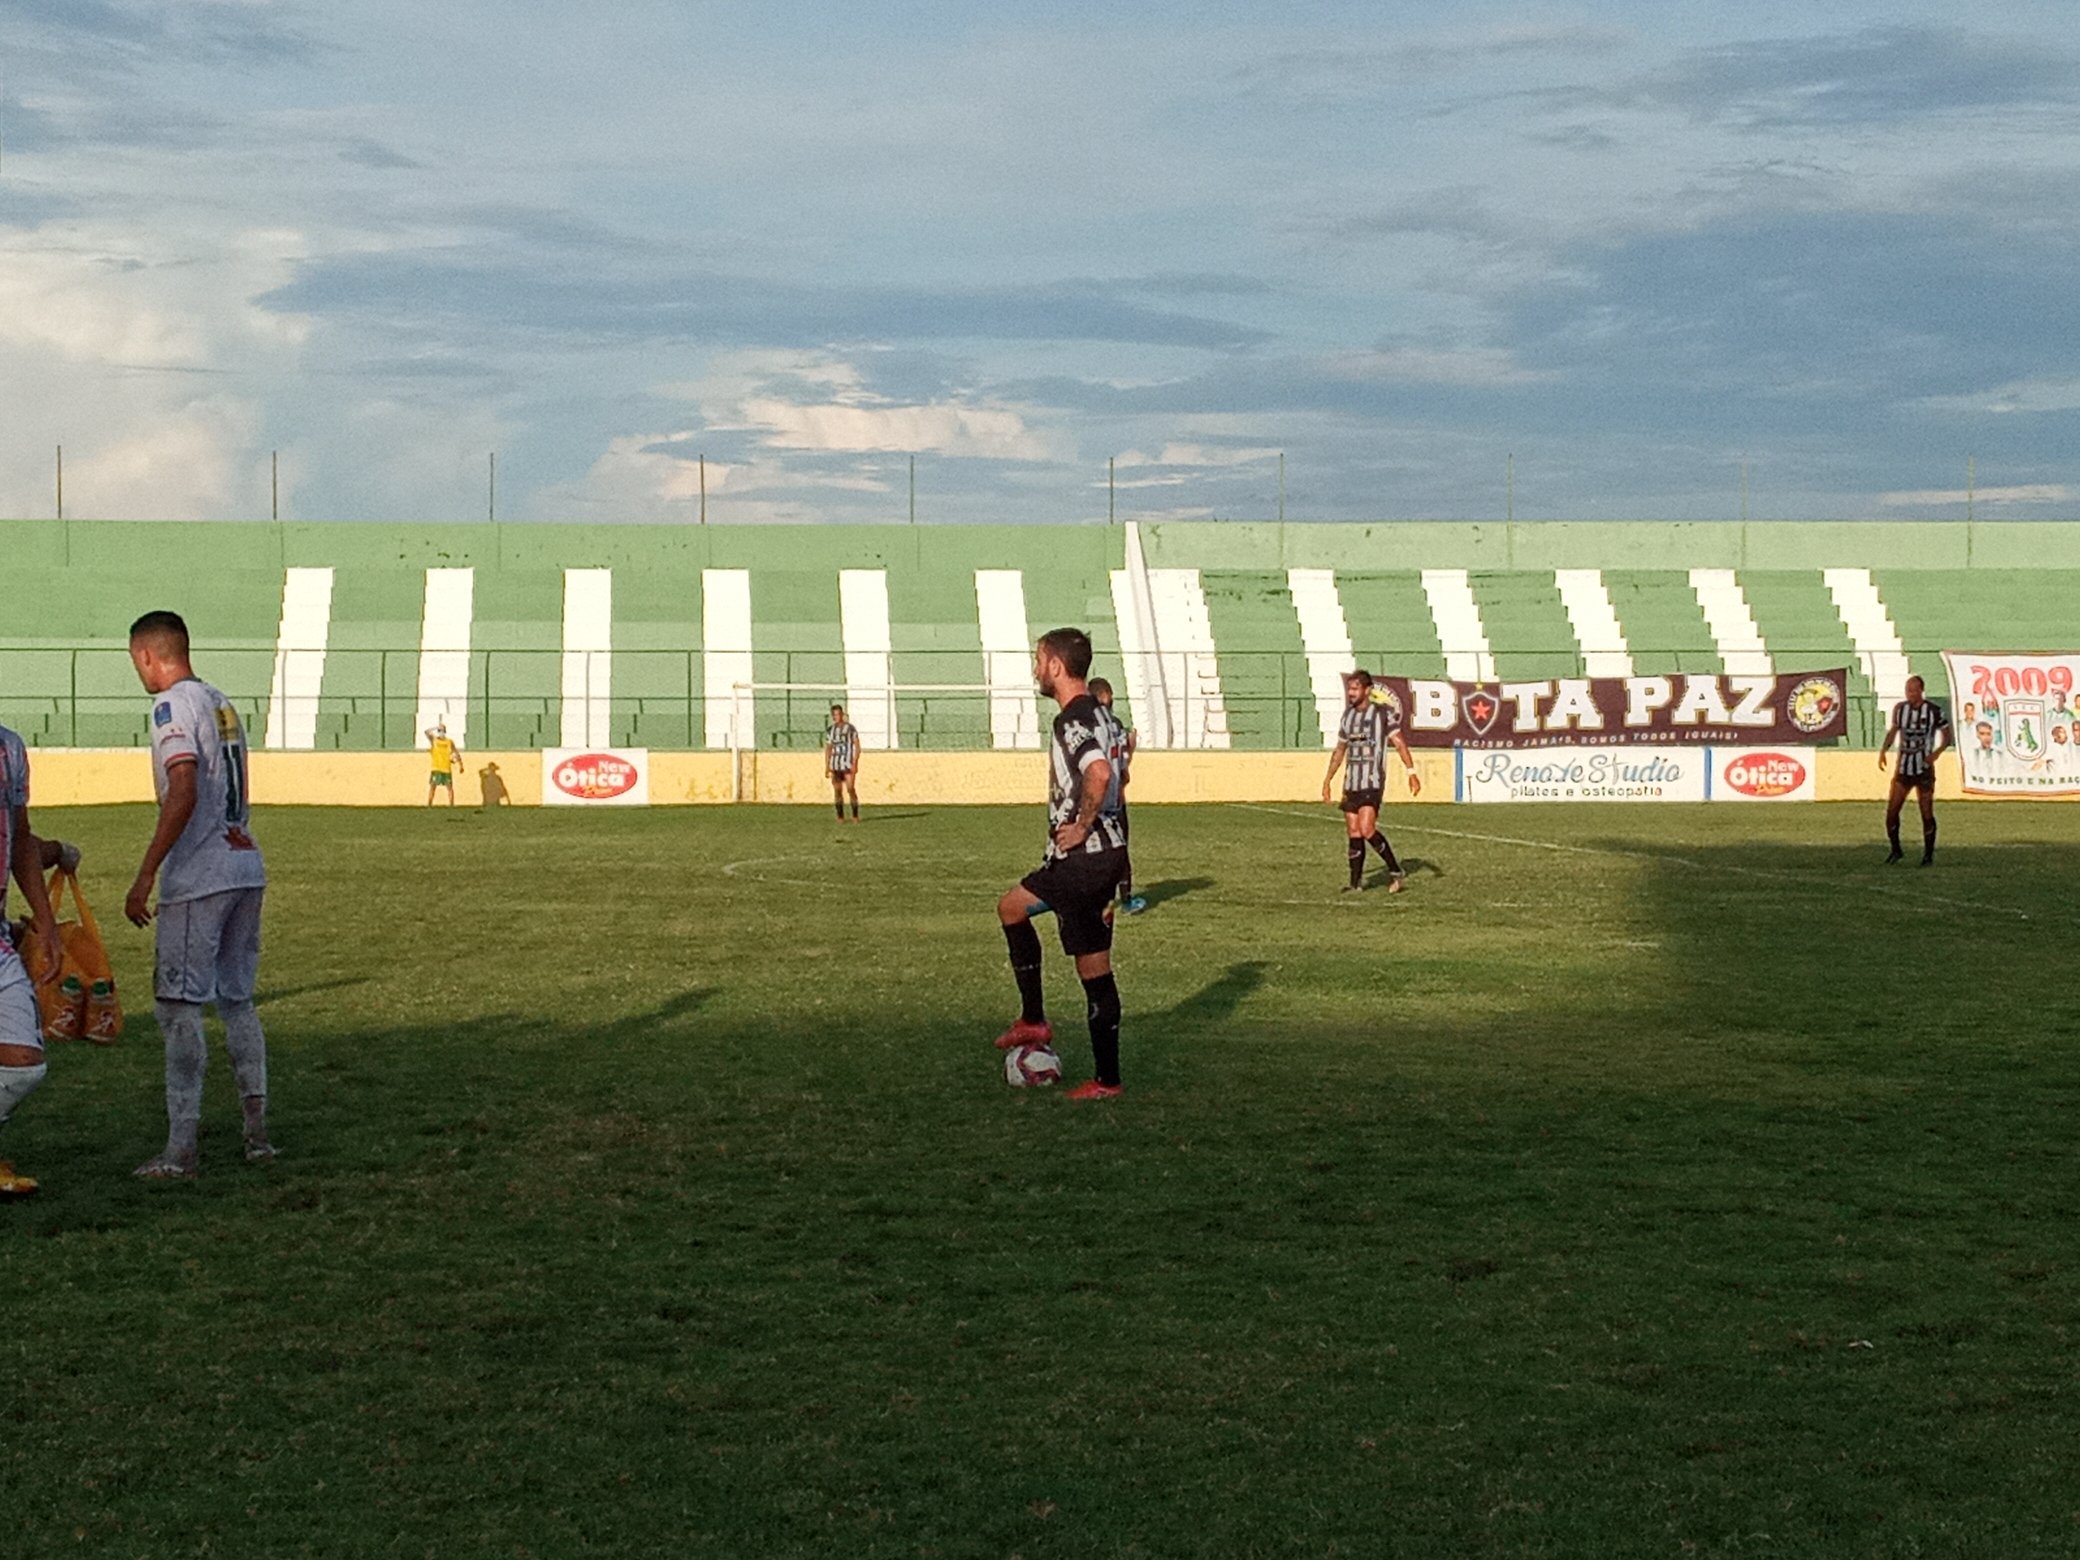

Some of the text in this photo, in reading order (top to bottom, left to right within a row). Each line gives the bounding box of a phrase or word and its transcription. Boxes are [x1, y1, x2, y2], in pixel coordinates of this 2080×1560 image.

[1970, 665, 2073, 697] 2009
[1624, 674, 1776, 728] PAZ
[1453, 738, 1514, 749] RACISMO
[1581, 734, 1626, 744] SOMOS
[1632, 730, 1677, 741] TODOS
[558, 761, 626, 788] Ótica
[598, 760, 632, 774] New
[1587, 753, 1685, 786] Studio
[1729, 759, 1794, 787] Ótica
[1767, 759, 1800, 773] New
[1511, 785, 1663, 799] pilates e osteopatia
